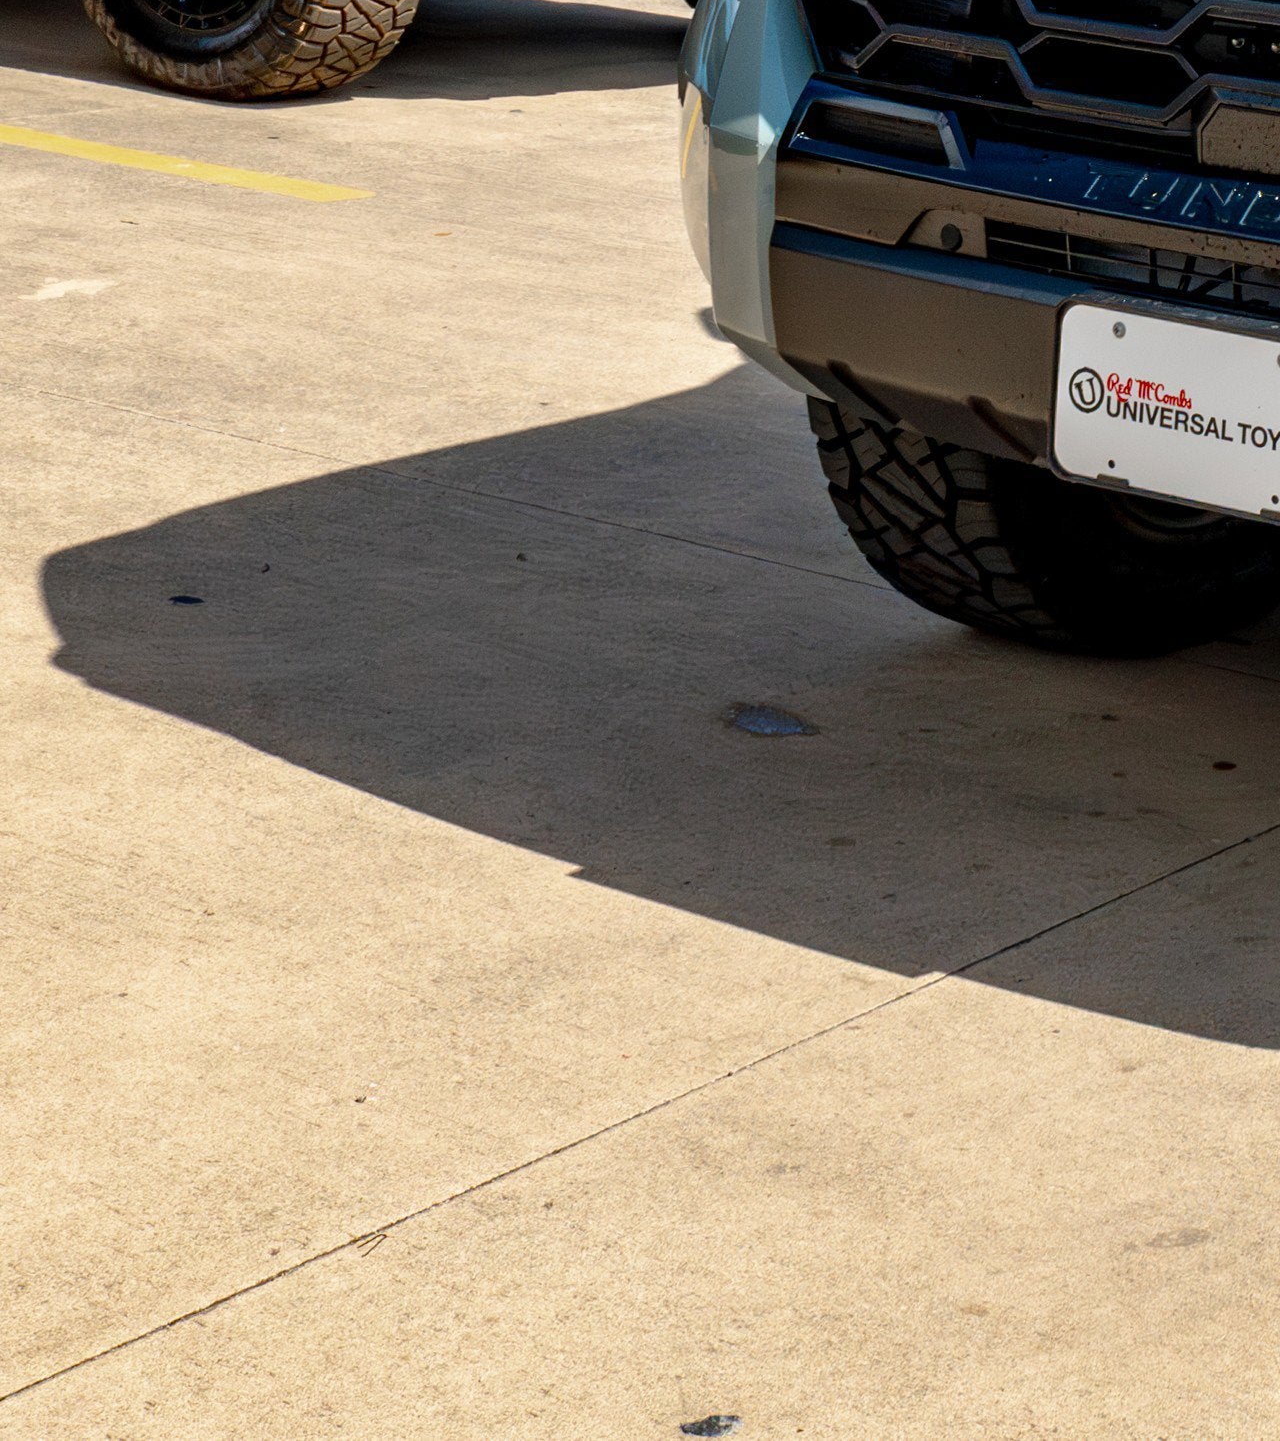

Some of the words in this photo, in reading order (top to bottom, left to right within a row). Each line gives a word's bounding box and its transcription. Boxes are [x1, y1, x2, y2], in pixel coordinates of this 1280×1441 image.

[1107, 373, 1132, 402] Red
[1136, 379, 1192, 409] McCombs
[1106, 396, 1233, 442] UNIVERSAL
